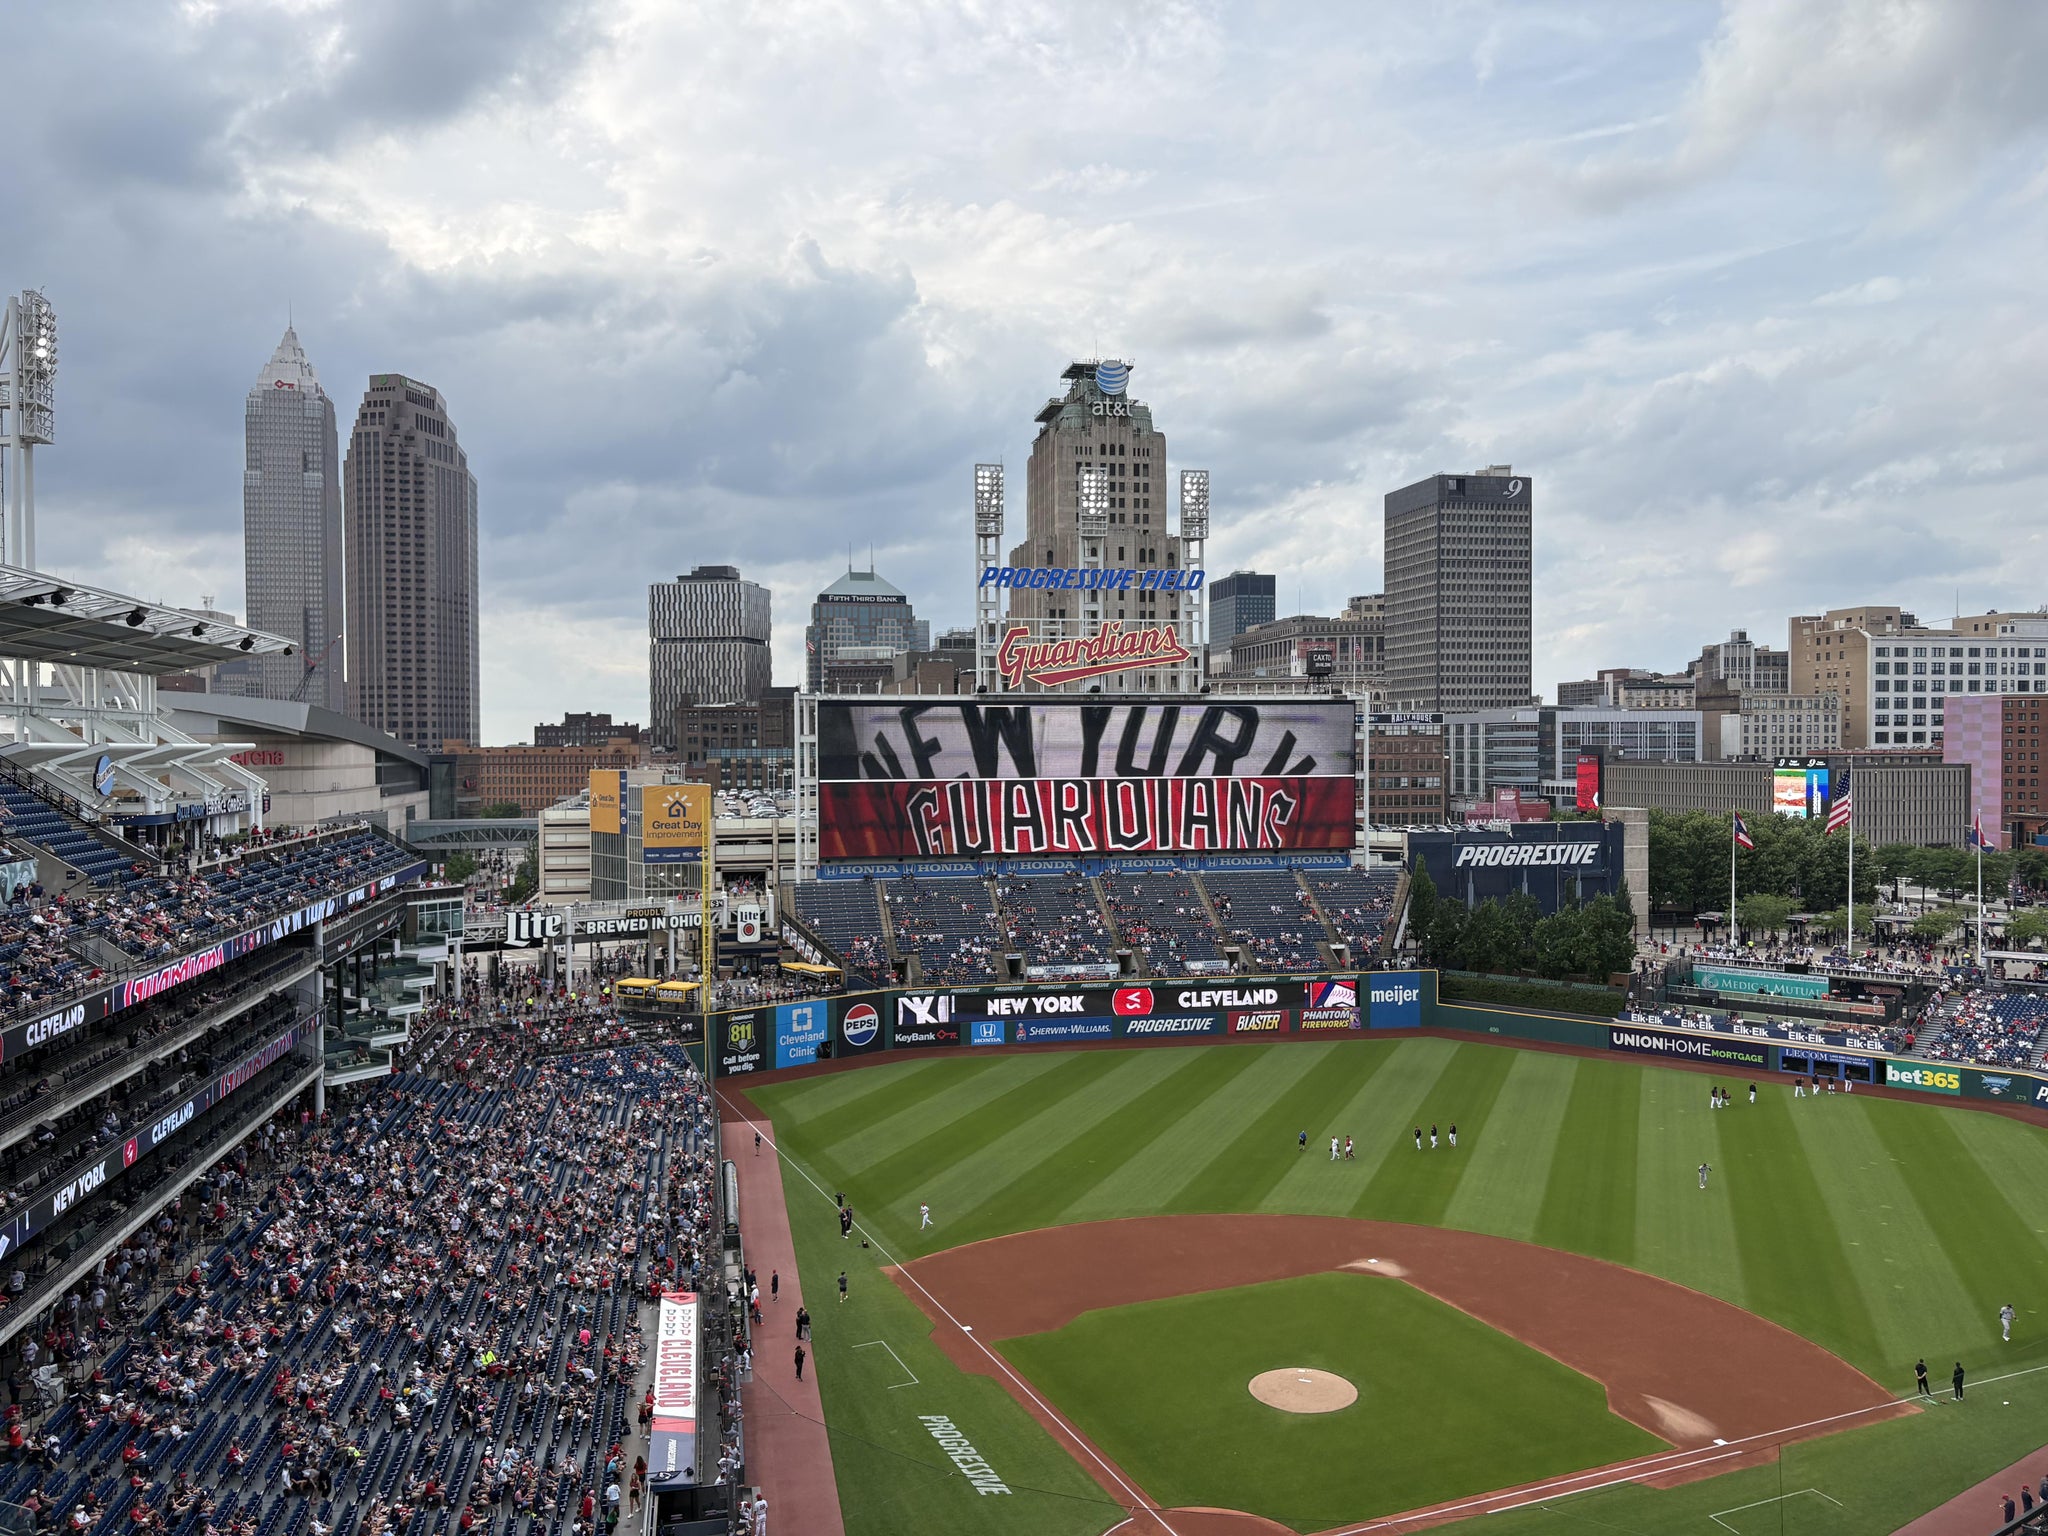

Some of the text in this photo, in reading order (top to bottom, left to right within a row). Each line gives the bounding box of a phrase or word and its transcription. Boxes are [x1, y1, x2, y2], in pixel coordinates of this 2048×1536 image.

[1092, 398, 1134, 417] at&t
[1503, 480, 1523, 499] 9
[979, 567, 1206, 591] PROGRESSIVE FIELD
[852, 595, 876, 603] THIRD
[998, 621, 1191, 689] Guardians
[1391, 713, 1411, 723] RALLY
[1412, 713, 1433, 723] HOUSE
[907, 780, 1297, 854] GUARDIANS
[652, 820, 702, 833] Great Day
[646, 831, 708, 840] Improvement
[1219, 857, 1274, 866] HONDA
[1290, 856, 1345, 865] HONDA
[1456, 844, 1599, 867] PROGRESSIVE
[839, 866, 899, 874] HONDA
[917, 864, 976, 872] HONDA
[1020, 862, 1076, 870] HONDA
[1121, 859, 1177, 868] HONDA
[627, 907, 665, 917] PROUDLY
[740, 911, 759, 923] Lite
[503, 911, 562, 947] Lite
[586, 914, 703, 935] BREWED IN OHIO
[1800, 975, 1827, 983] Guardians
[1371, 985, 1419, 1002] meijer
[1773, 984, 1823, 998] MUTUAL
[987, 995, 1085, 1015] NEW YORK
[1178, 989, 1278, 1008] CLEVELAND
[1303, 1010, 1349, 1020] PHANTOM
[26, 1004, 85, 1047] CLEVELAND
[846, 1019, 876, 1030] PEPSI
[1127, 1018, 1214, 1033] PROGRESSIVE
[1235, 1014, 1281, 1031] BLASTER
[1302, 1019, 1349, 1029] FIREWORKS
[730, 1022, 752, 1042] 811
[780, 1030, 825, 1046] Cleveland
[895, 1032, 935, 1043] KeyBank
[723, 1052, 760, 1065] Call before
[789, 1046, 816, 1058] Clinic
[1711, 1050, 1763, 1063] MORTGAGE
[729, 1061, 755, 1074] you dig.
[1887, 1065, 1960, 1090] bet365
[151, 1101, 194, 1144] CLEVELAND
[53, 1161, 106, 1216] NEW YORK
[657, 1339, 692, 1408] CLEVELAND
[918, 1415, 1013, 1496] PROGRESSIVE
